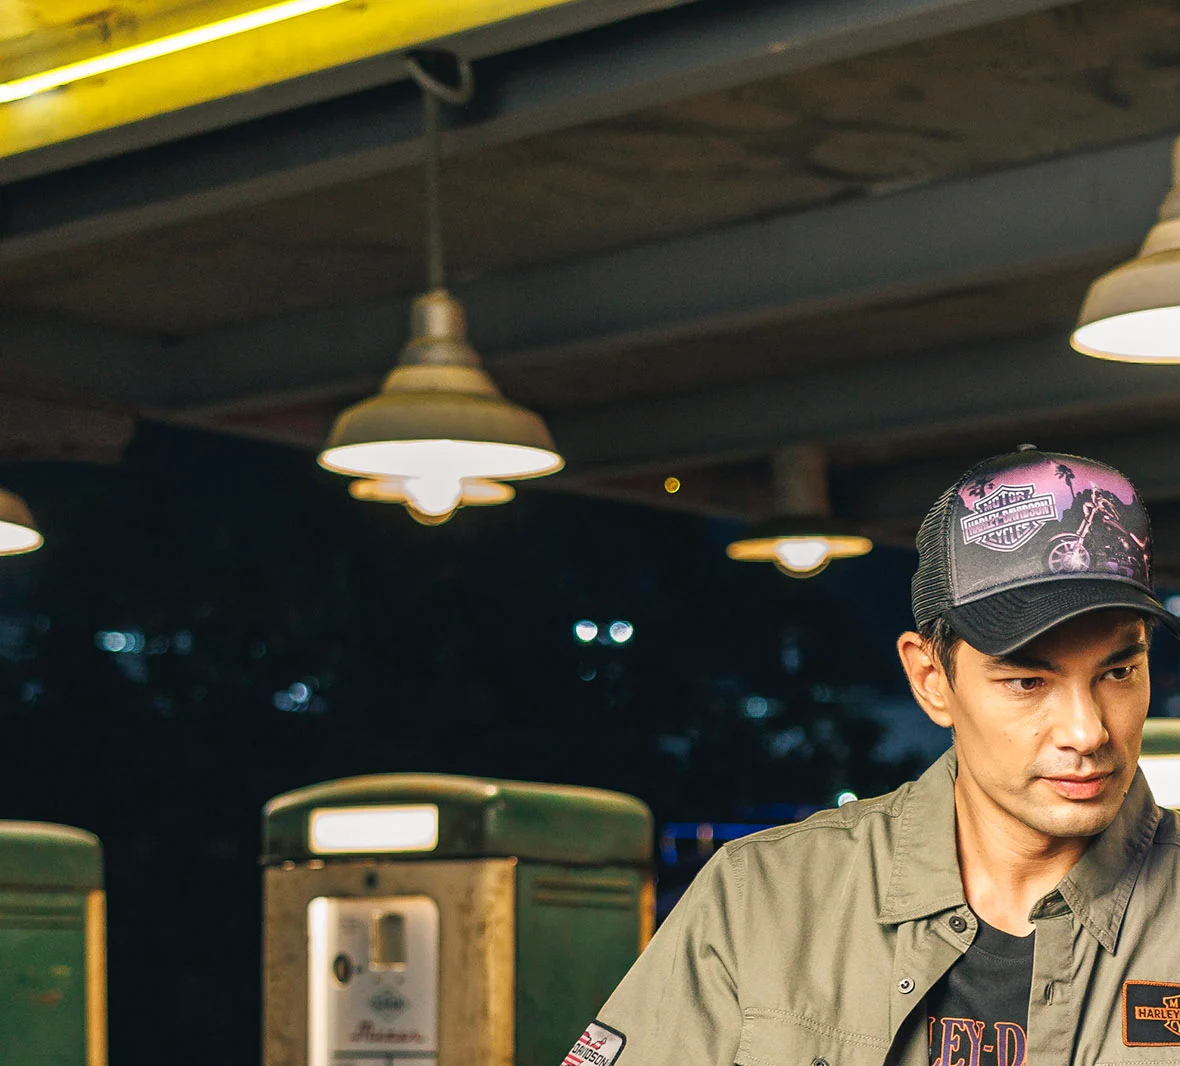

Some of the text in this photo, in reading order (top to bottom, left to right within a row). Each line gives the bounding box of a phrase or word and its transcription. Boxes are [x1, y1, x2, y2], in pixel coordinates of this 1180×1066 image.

[983, 491, 1025, 512] MOTOR
[966, 500, 1051, 536] HARLEY-DAVIDSON
[988, 522, 1031, 545] CYCLES
